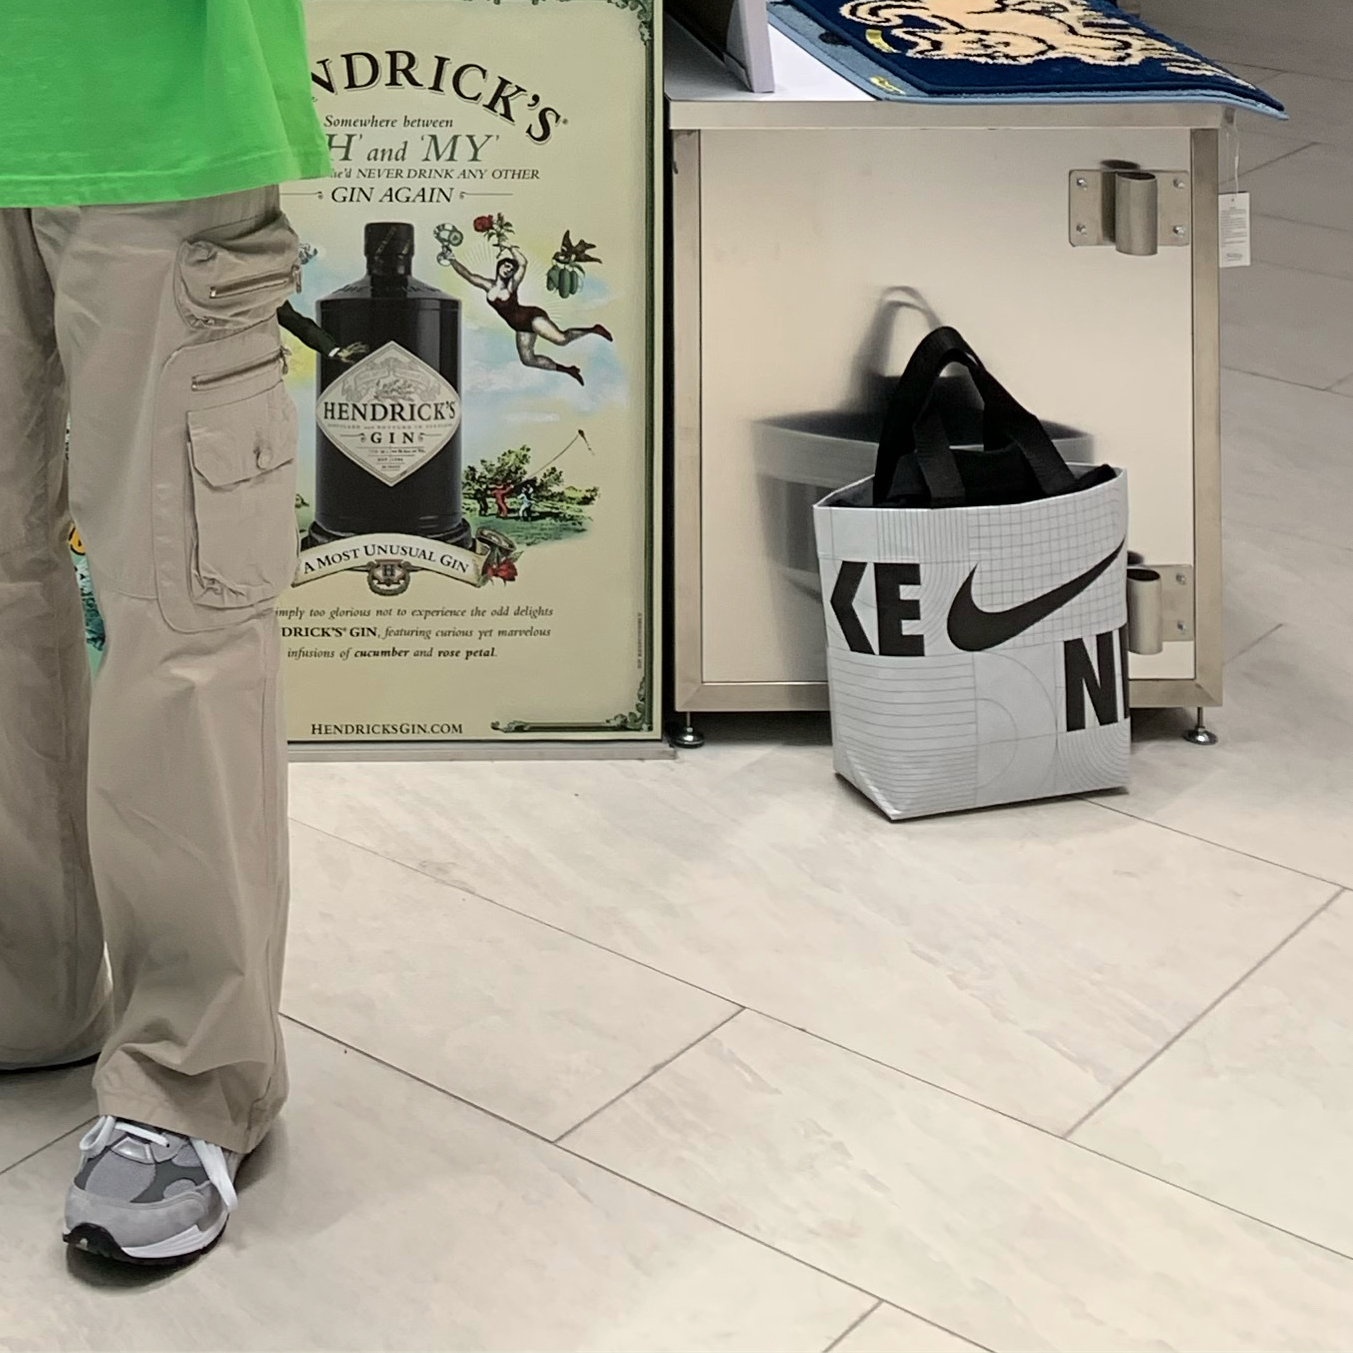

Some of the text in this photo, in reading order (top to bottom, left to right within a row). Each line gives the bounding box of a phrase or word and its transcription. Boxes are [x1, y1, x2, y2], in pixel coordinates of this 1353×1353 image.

[323, 114, 454, 129] Somewhere between
[366, 140, 407, 162] and
[356, 168, 540, 180] NEVER DRINK ANY OTHER
[331, 186, 455, 203] GIN AGAIN
[324, 400, 455, 422] HENDRICK'S
[370, 432, 414, 444] GIN
[303, 544, 470, 574] A MOST UNUSUAL GIN
[310, 608, 325, 616] too
[329, 607, 371, 620] glorious
[376, 608, 392, 616] not
[397, 608, 407, 616] to
[411, 607, 466, 619] experience
[471, 607, 486, 616] the
[491, 607, 509, 616] odd
[513, 606, 554, 619] delights
[349, 627, 381, 638] GIN,
[382, 627, 431, 639] featuring
[435, 628, 473, 637] curious
[478, 628, 493, 639] yet
[497, 627, 551, 637] marvelous
[287, 647, 498, 660] infusions of cucumber and rose petal.
[311, 722, 464, 735] HENDRICKSGIN.COM
